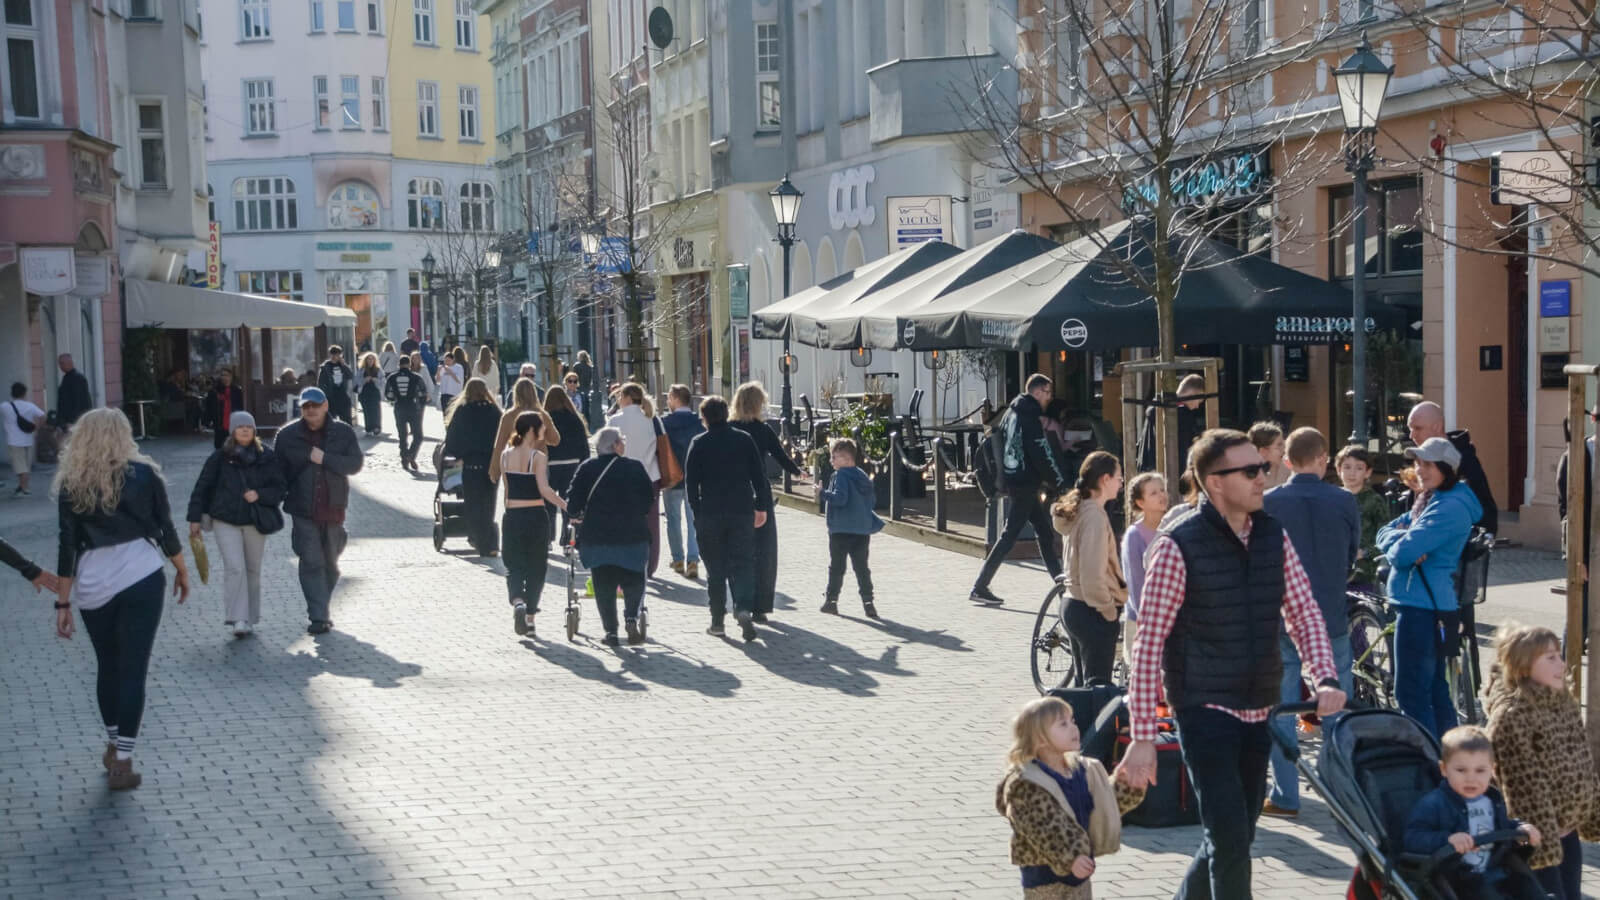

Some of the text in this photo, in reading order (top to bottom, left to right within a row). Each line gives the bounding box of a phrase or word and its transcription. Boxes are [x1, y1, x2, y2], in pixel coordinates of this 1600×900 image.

[899, 216, 939, 224] VICTUS
[208, 223, 218, 284] KANTOR
[1063, 328, 1086, 336] PEPSI
